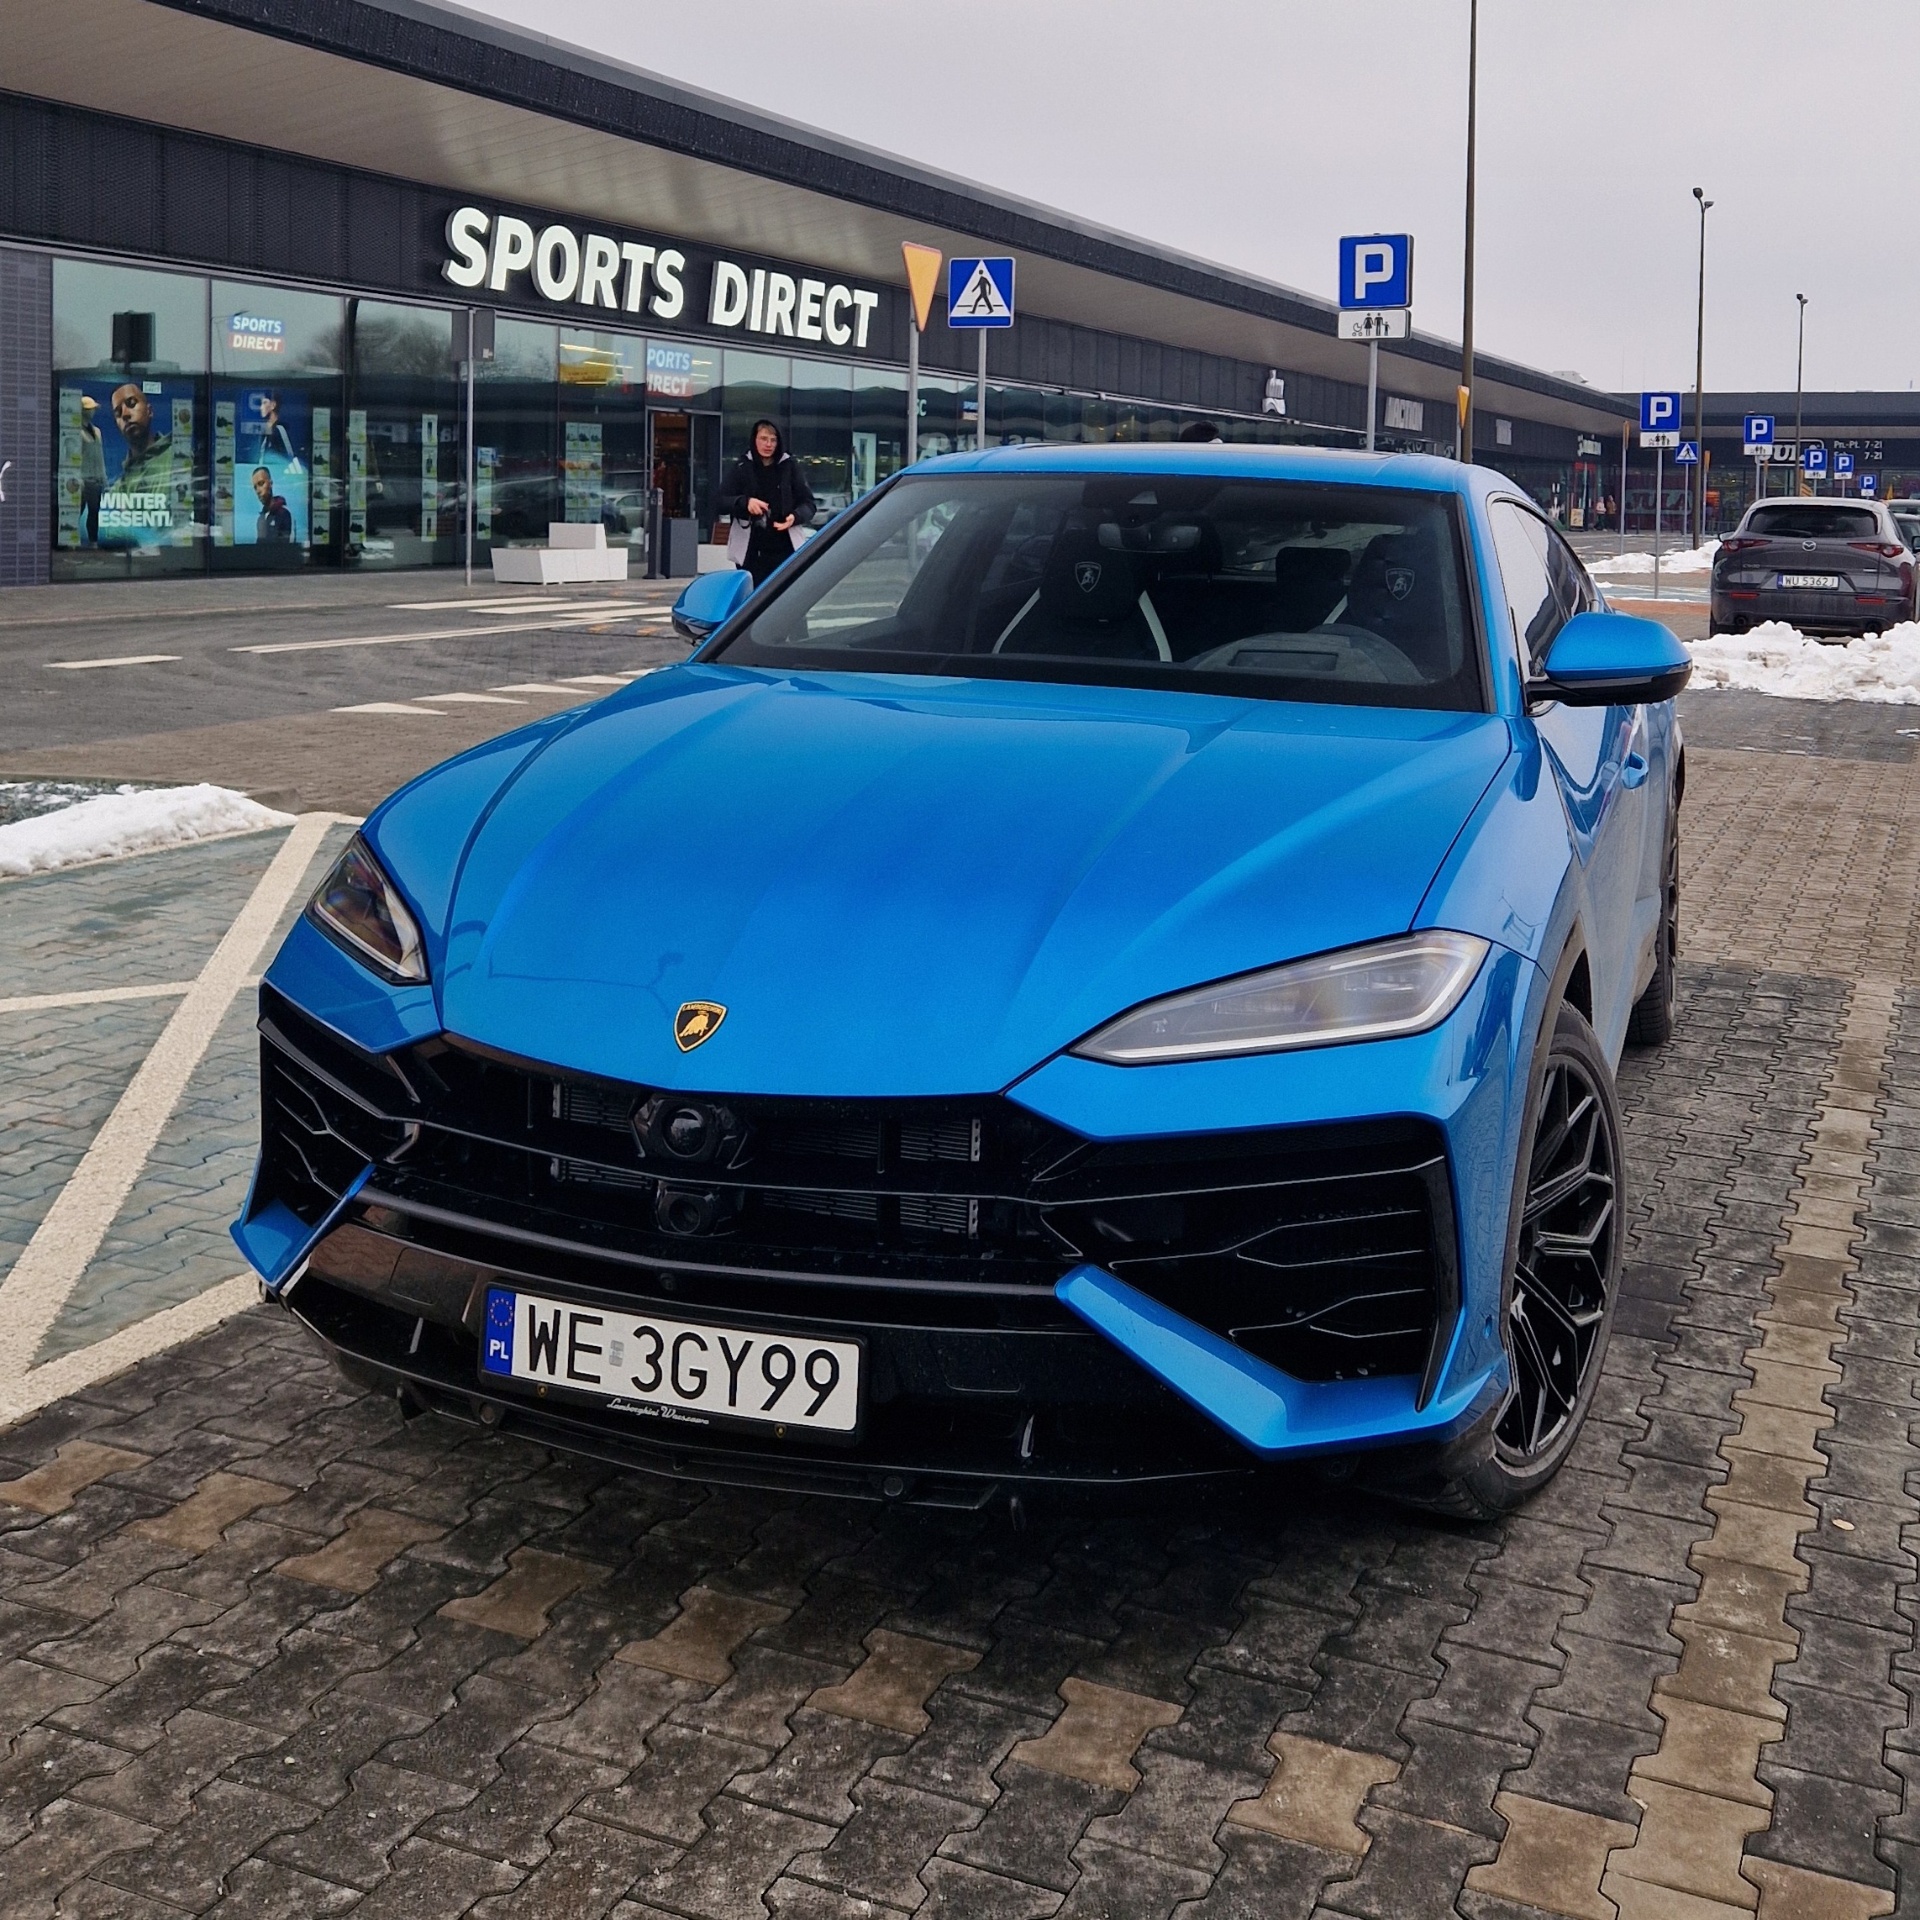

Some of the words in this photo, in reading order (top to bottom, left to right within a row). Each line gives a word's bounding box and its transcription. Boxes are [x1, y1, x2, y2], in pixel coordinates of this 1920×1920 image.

[442, 207, 686, 319] SPORTS
[709, 261, 879, 348] DIRECT
[1354, 243, 1394, 300] P
[232, 316, 282, 334] SPORTS
[232, 335, 282, 351] DIRECT
[647, 348, 691, 370] PORTS
[647, 373, 690, 394] IRECT
[1650, 396, 1673, 426] P
[1751, 418, 1768, 440] P
[1864, 440, 1883, 449] 7-21
[1809, 451, 1823, 468] P
[1838, 456, 1850, 470] P
[1864, 451, 1883, 460] 7-21
[1863, 476, 1873, 488] P
[100, 492, 167, 509] WINTER
[98, 510, 195, 528] ESSENTI
[1785, 575, 1800, 586] WU
[1802, 576, 1835, 587] 5362J
[489, 1338, 510, 1360] PL
[528, 1304, 604, 1385] WE
[630, 1324, 841, 1418] 3GY99
[606, 1398, 660, 1416] Lamborghini
